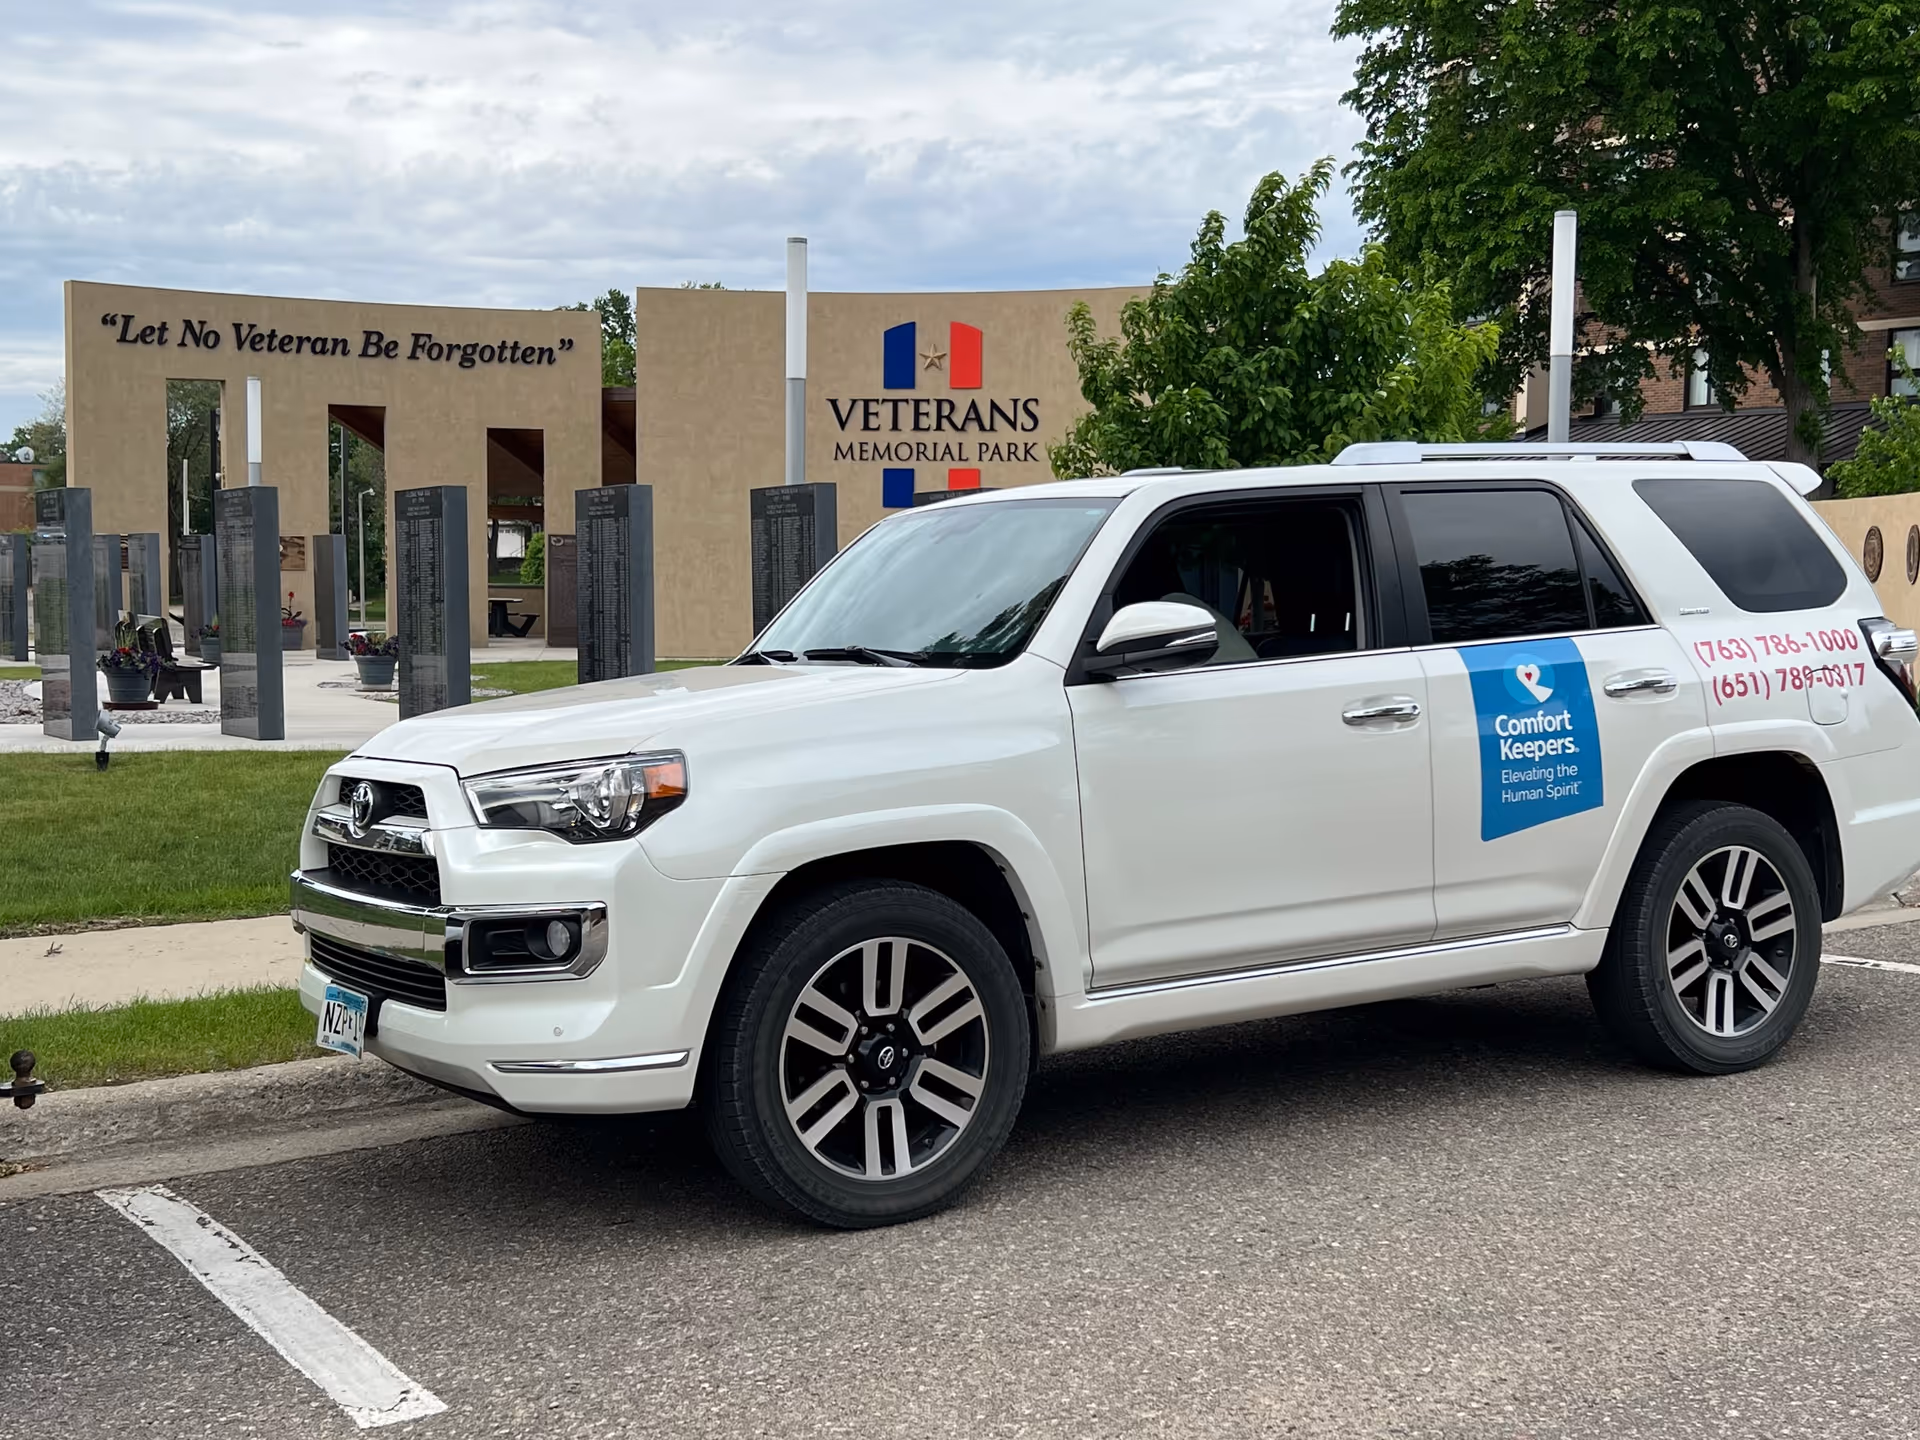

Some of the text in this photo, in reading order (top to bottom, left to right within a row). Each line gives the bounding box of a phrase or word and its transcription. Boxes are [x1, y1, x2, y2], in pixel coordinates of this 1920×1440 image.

[177, 319, 221, 350] No
[232, 322, 351, 356] Veteran
[358, 330, 399, 359] Be
[825, 397, 1040, 433] VETERANS
[833, 441, 1040, 462] MEMORIAL PARK
[1693, 628, 1859, 669] (763) 786-1000
[1712, 662, 1866, 707] (651) 789-0317
[1495, 709, 1573, 737] Comfort
[1501, 763, 1579, 784] Elevating the
[1502, 787, 1544, 804] Human
